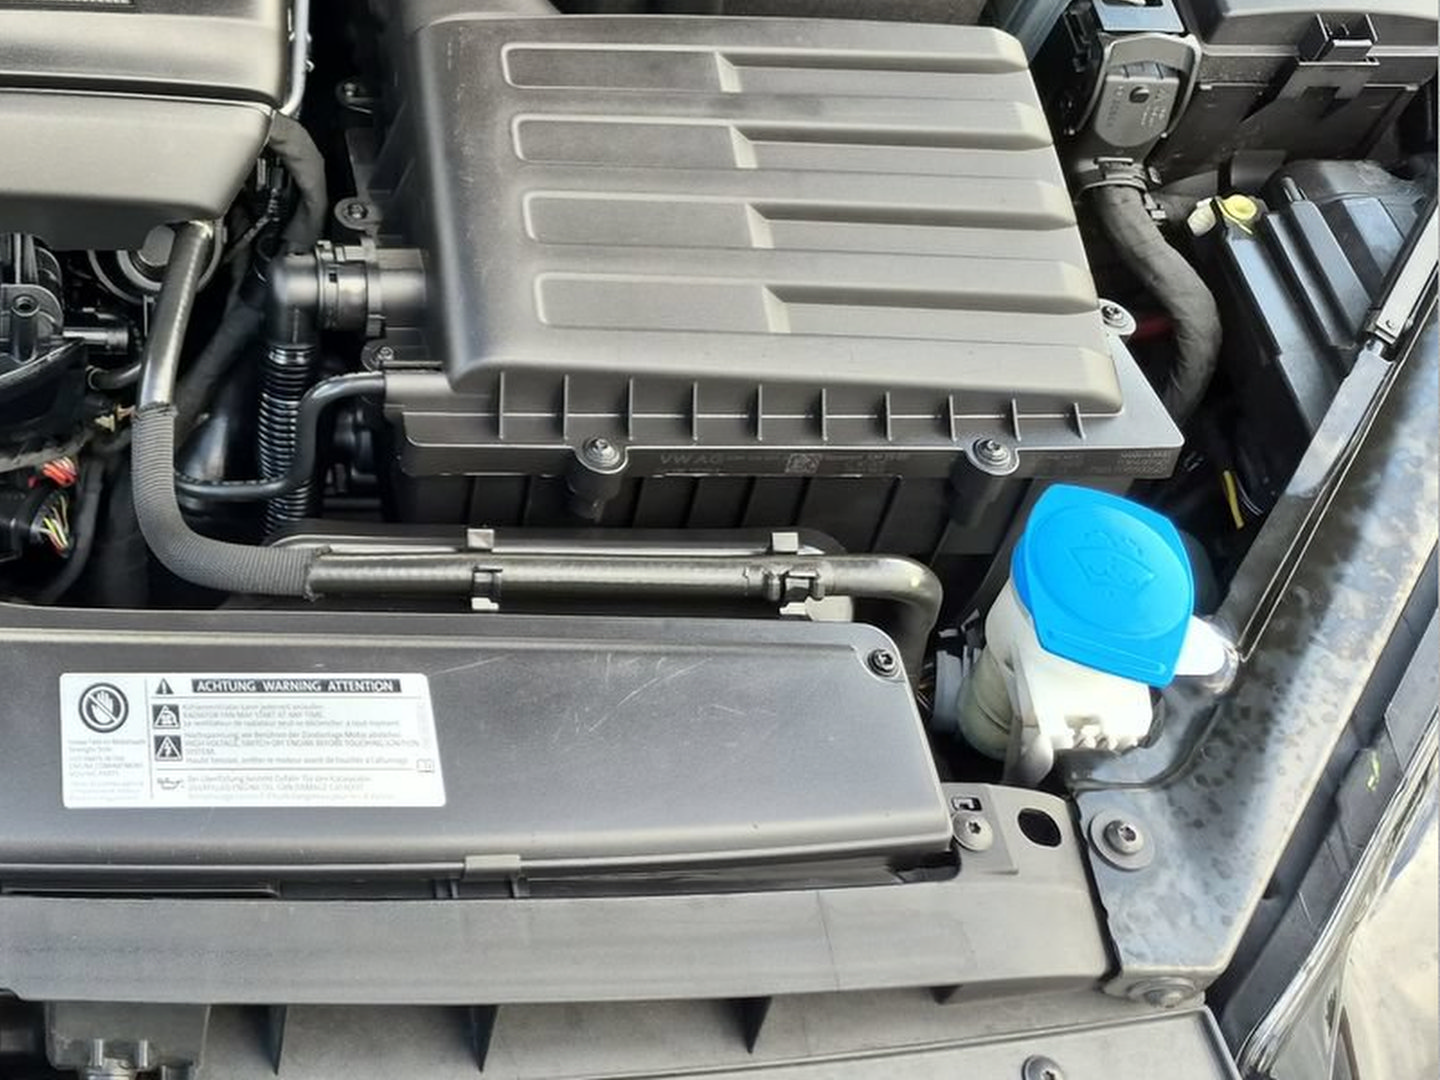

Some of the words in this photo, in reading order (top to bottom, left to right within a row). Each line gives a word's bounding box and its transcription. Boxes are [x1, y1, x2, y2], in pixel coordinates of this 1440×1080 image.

[197, 680, 256, 693] ACHTUNG
[262, 680, 322, 693] WARNING
[328, 680, 394, 693] ATTENTION
